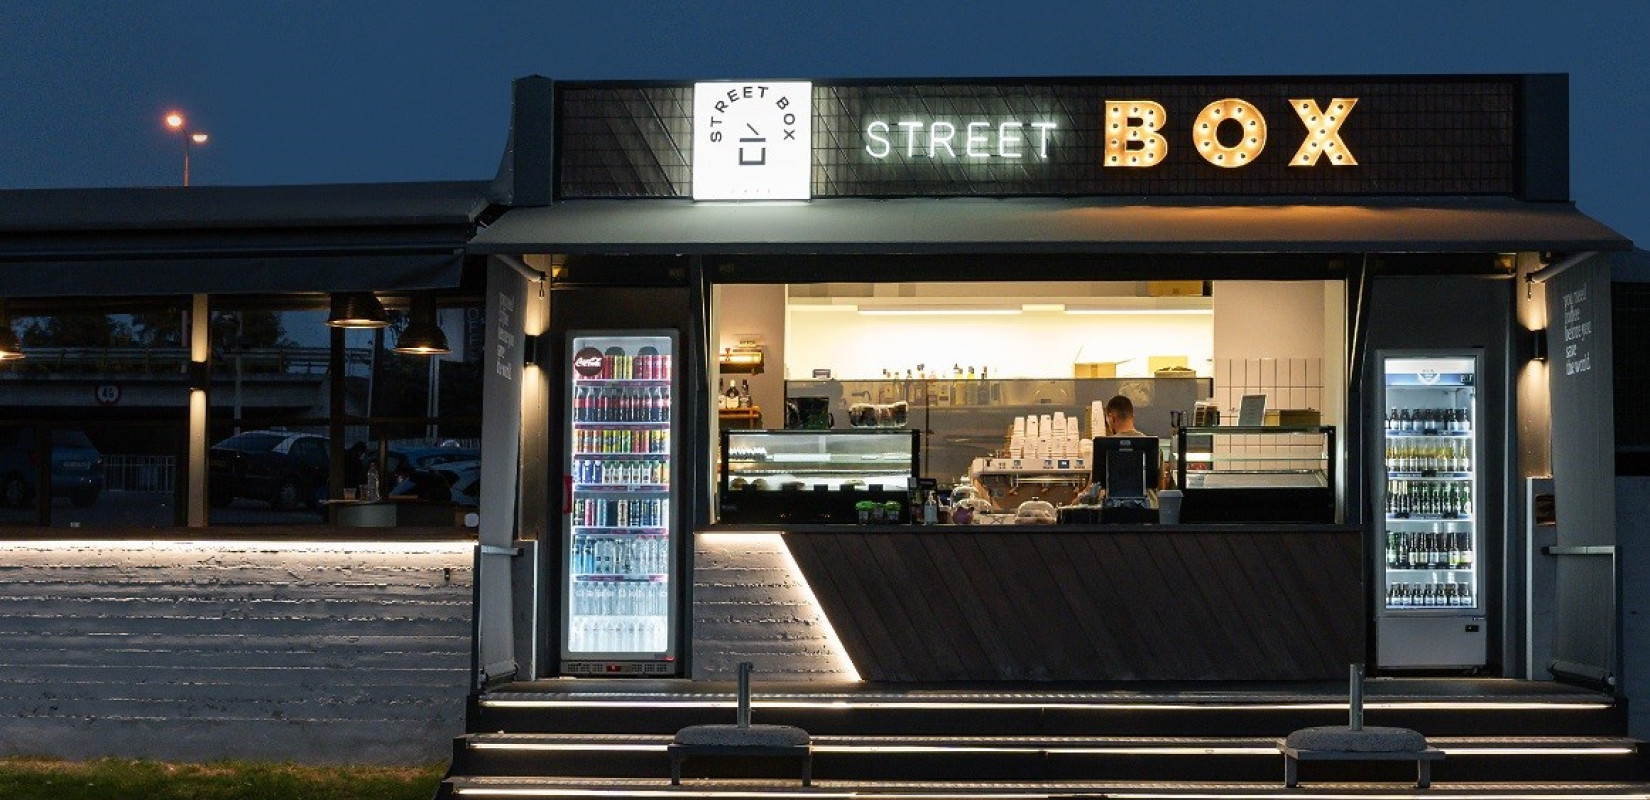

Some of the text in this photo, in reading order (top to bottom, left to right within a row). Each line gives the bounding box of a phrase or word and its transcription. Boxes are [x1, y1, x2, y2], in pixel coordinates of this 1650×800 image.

[710, 86, 796, 142] STREET BOX
[866, 97, 1359, 168] STREET BOX
